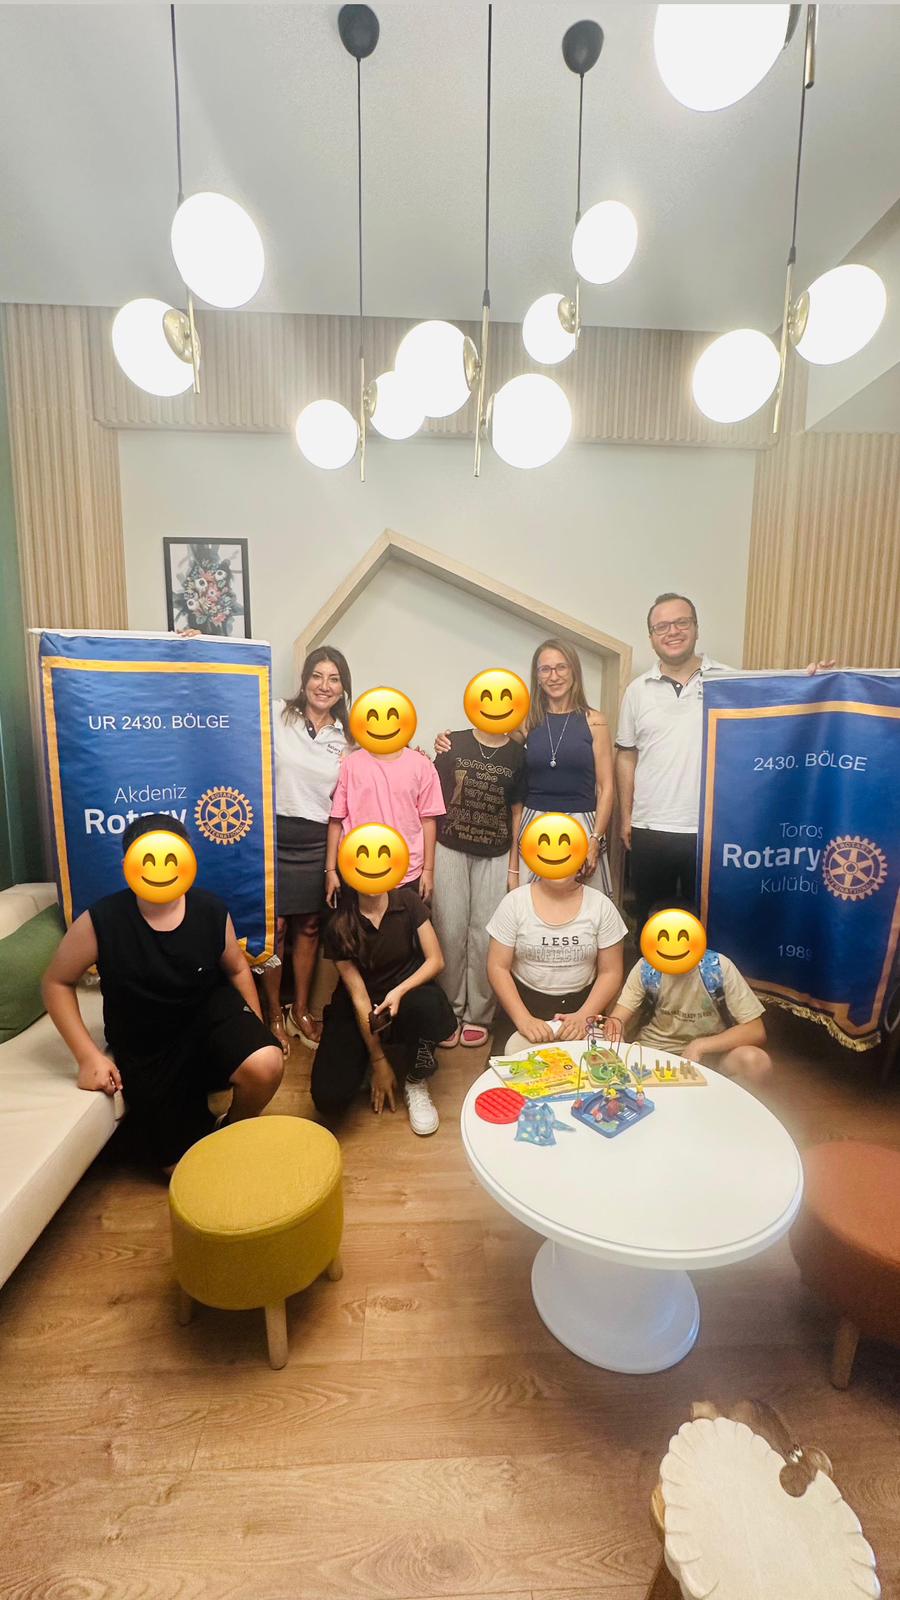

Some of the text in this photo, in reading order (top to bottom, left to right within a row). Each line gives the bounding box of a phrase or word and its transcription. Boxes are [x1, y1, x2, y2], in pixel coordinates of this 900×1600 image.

[88, 713, 230, 730] UR 2430. BÖLGE
[753, 750, 868, 772] 2430. BÖLGE
[114, 784, 187, 804] Akdeniz
[780, 822, 823, 839] Toros
[722, 843, 821, 872] Rotary
[541, 935, 579, 946] LESS
